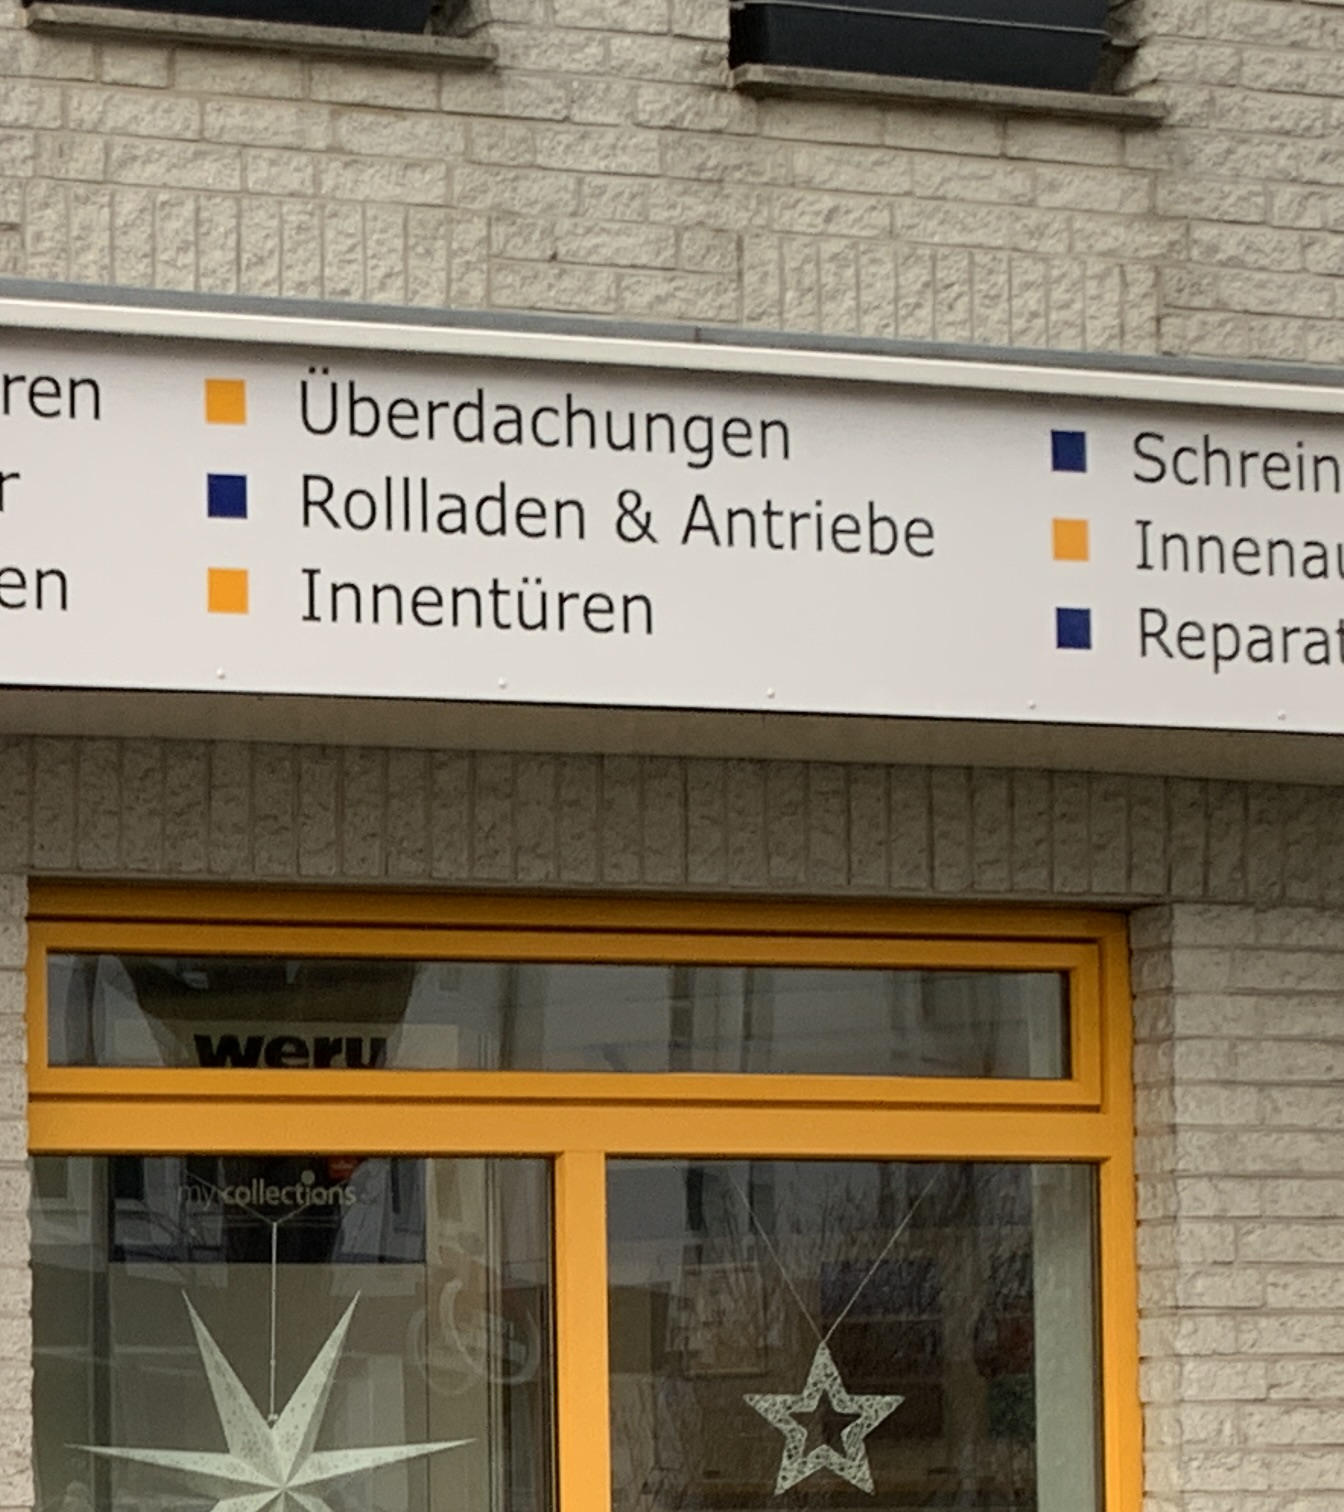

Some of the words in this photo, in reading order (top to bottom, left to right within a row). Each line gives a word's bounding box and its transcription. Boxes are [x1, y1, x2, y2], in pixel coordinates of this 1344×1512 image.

[299, 367, 792, 470] Überdachungen
[1133, 430, 1341, 493] Schrein
[300, 473, 587, 541] Rollladen
[615, 489, 658, 546] &
[681, 494, 936, 558] Antriebe
[300, 567, 655, 635] Innentüren
[193, 1033, 388, 1069] weru
[223, 1168, 357, 1206] collections
